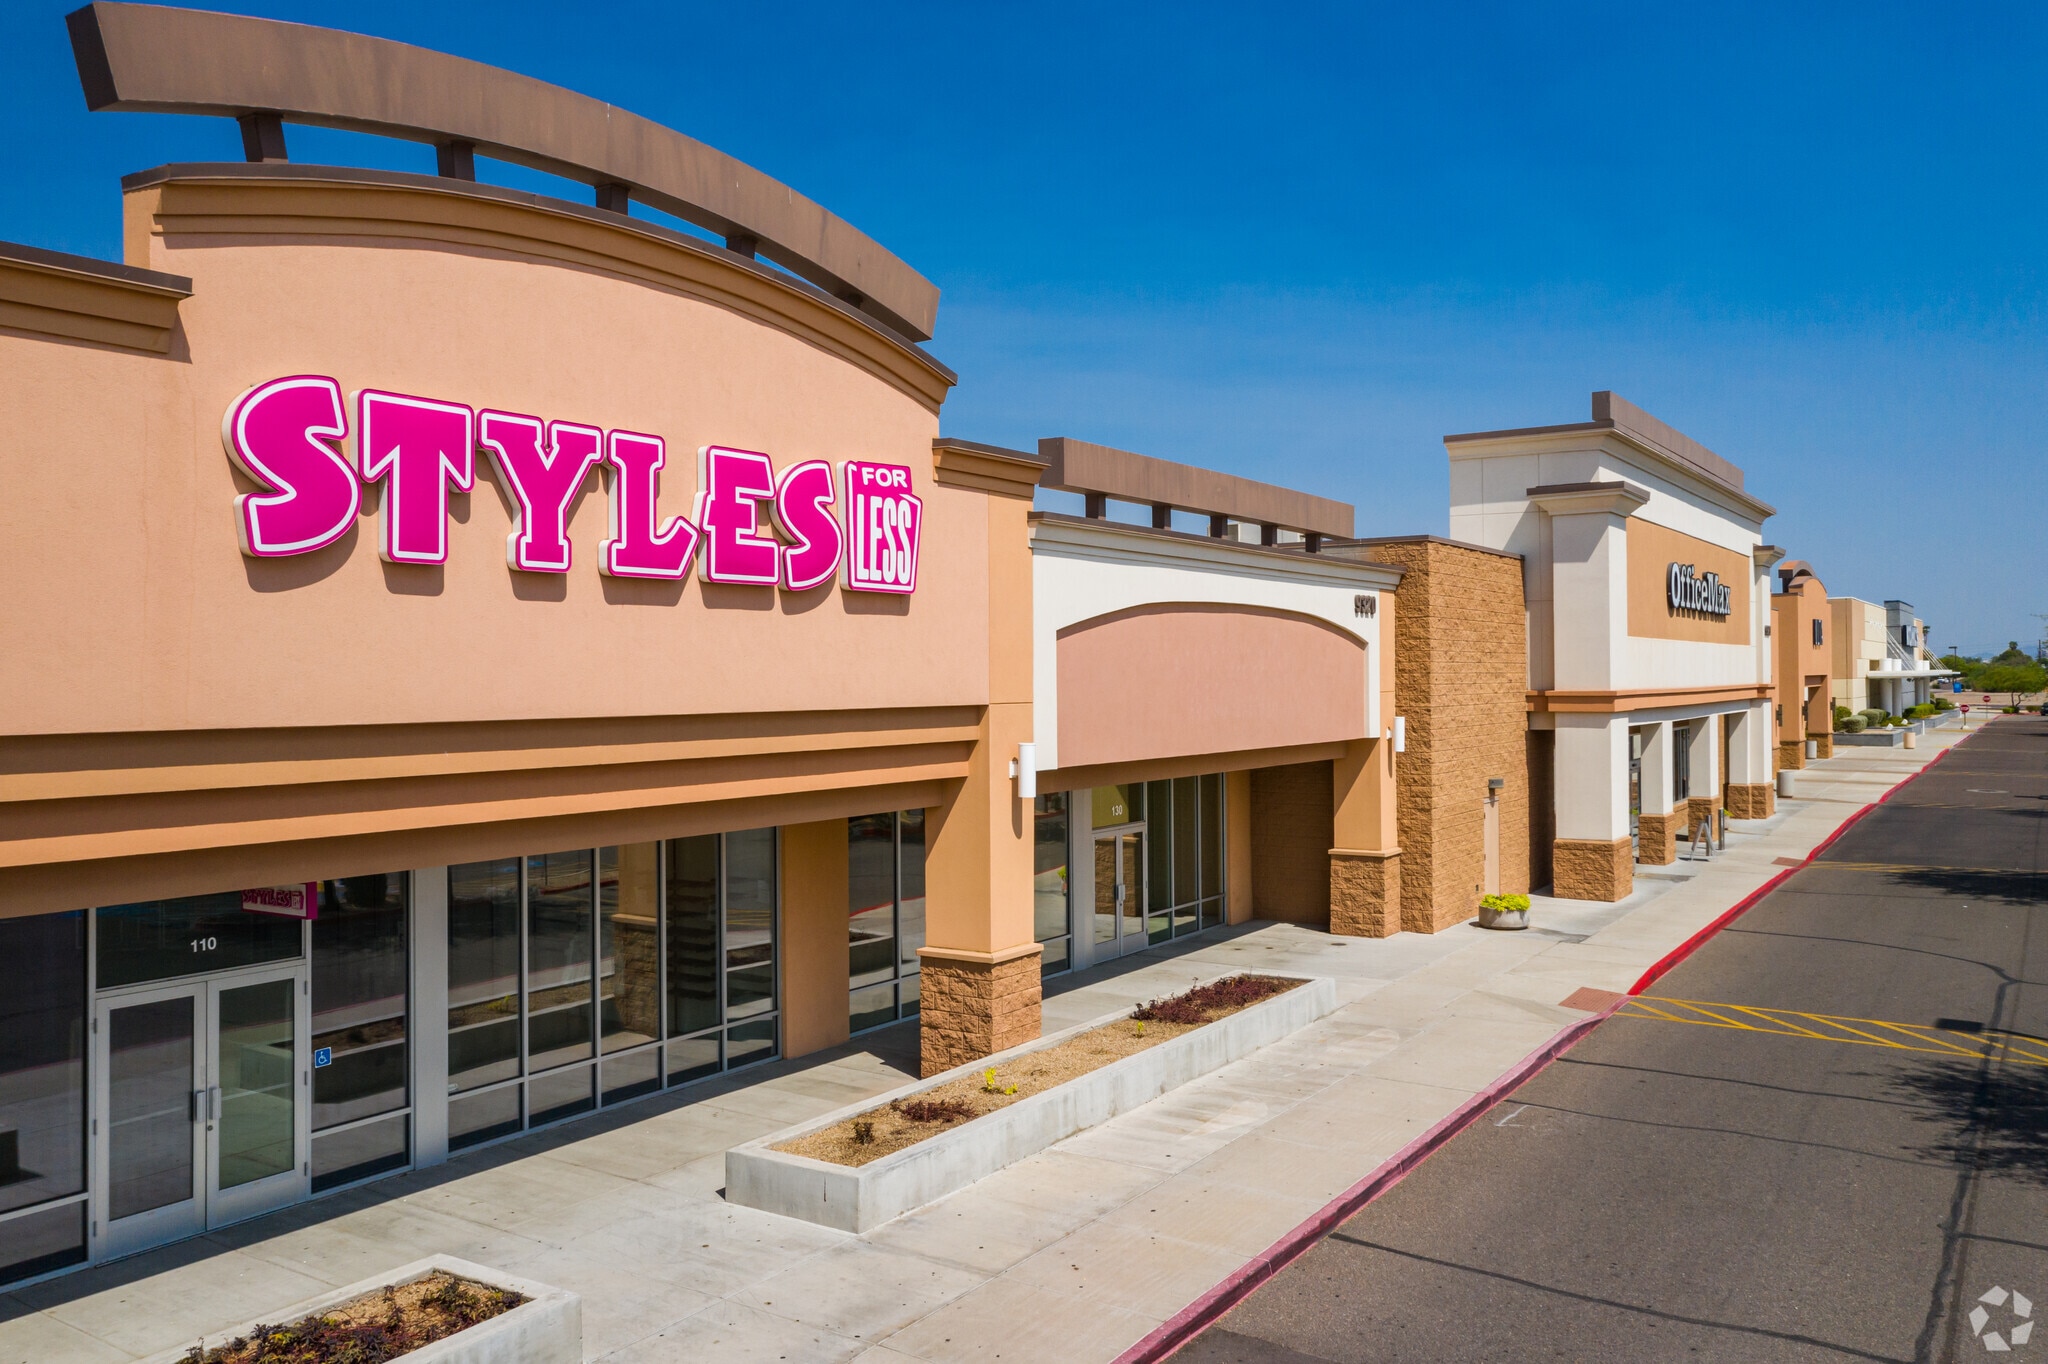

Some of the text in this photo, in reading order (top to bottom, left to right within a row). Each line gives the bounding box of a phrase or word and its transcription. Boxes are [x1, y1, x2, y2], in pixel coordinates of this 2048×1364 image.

[226, 374, 845, 592] STYLES
[861, 466, 908, 488] FOR
[856, 493, 912, 584] LESS
[1667, 562, 1731, 615] OfficeMax
[1111, 804, 1123, 816] 130
[190, 936, 217, 953] 110
